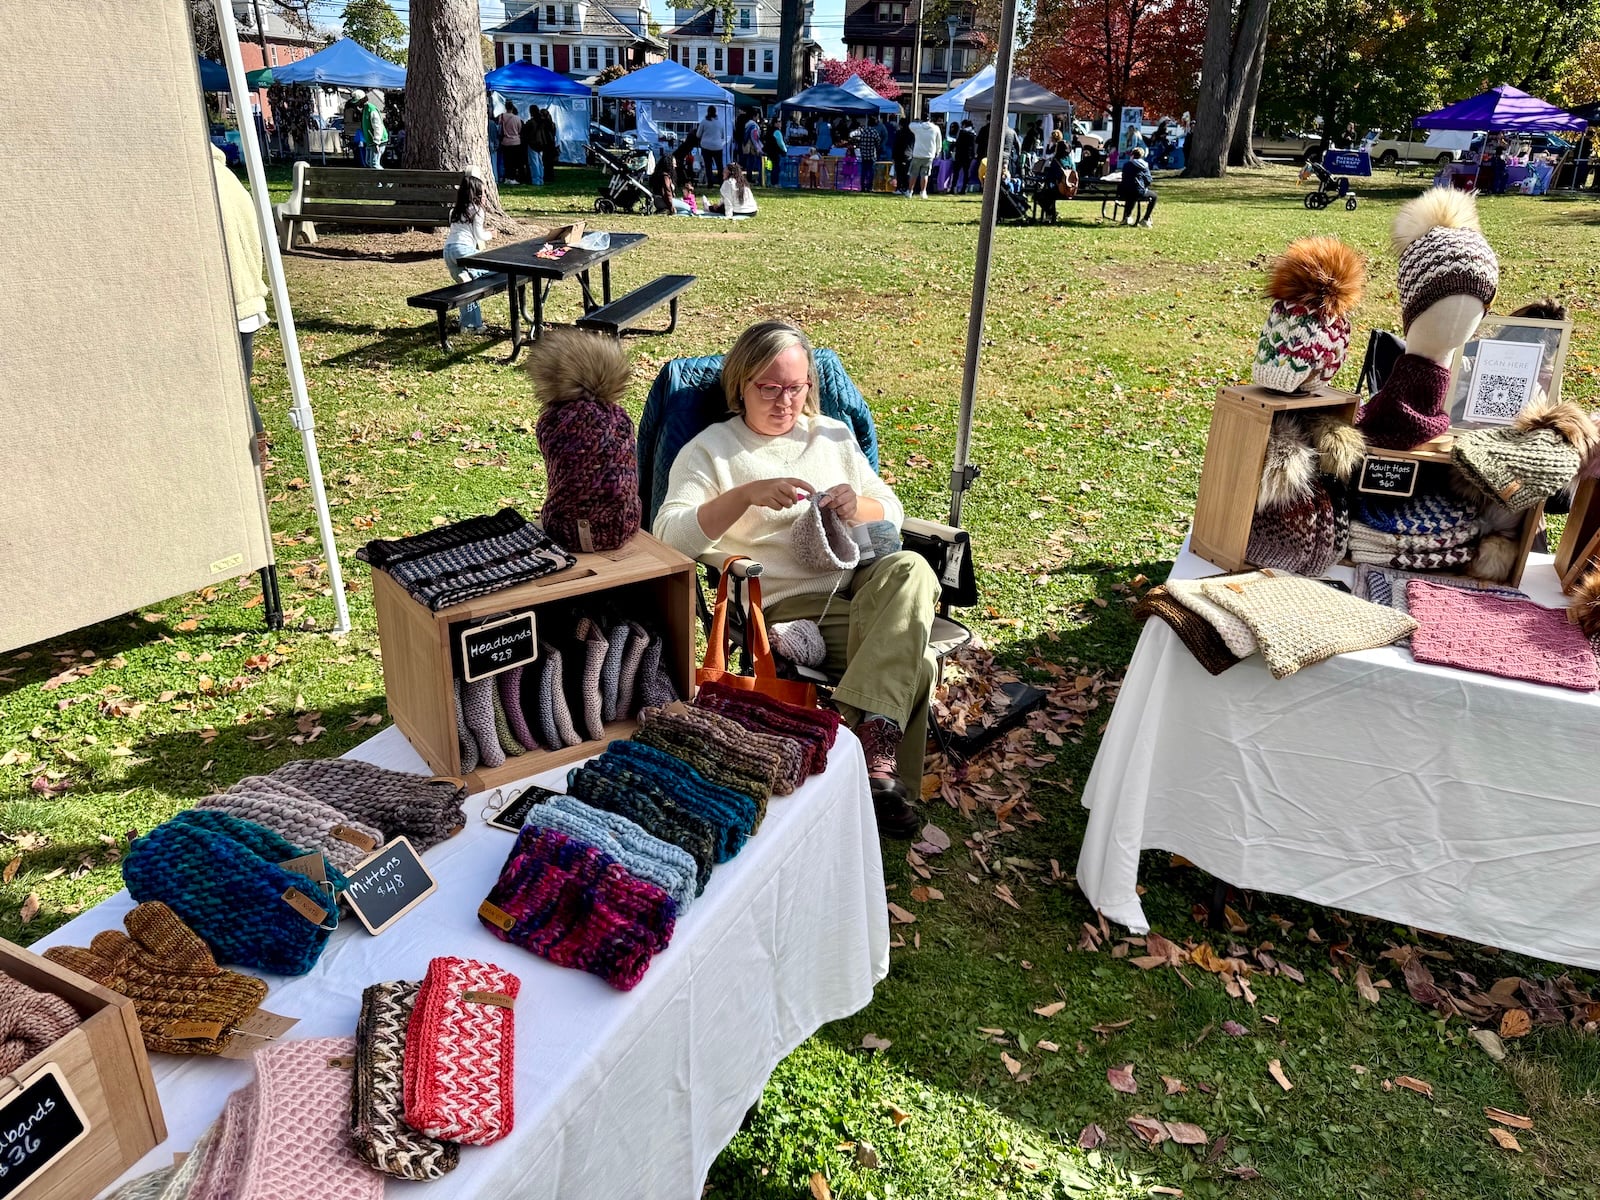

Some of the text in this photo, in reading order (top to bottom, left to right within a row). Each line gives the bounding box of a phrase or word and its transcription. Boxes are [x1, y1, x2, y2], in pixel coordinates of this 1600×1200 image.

[1482, 359, 1528, 369] SCAN HERE
[1369, 462, 1411, 473] Adult Hats
[1379, 480, 1395, 488] $60
[470, 629, 532, 658] Headbands
[490, 648, 513, 662] $28
[349, 856, 401, 899] Mittens
[377, 873, 405, 897] $48
